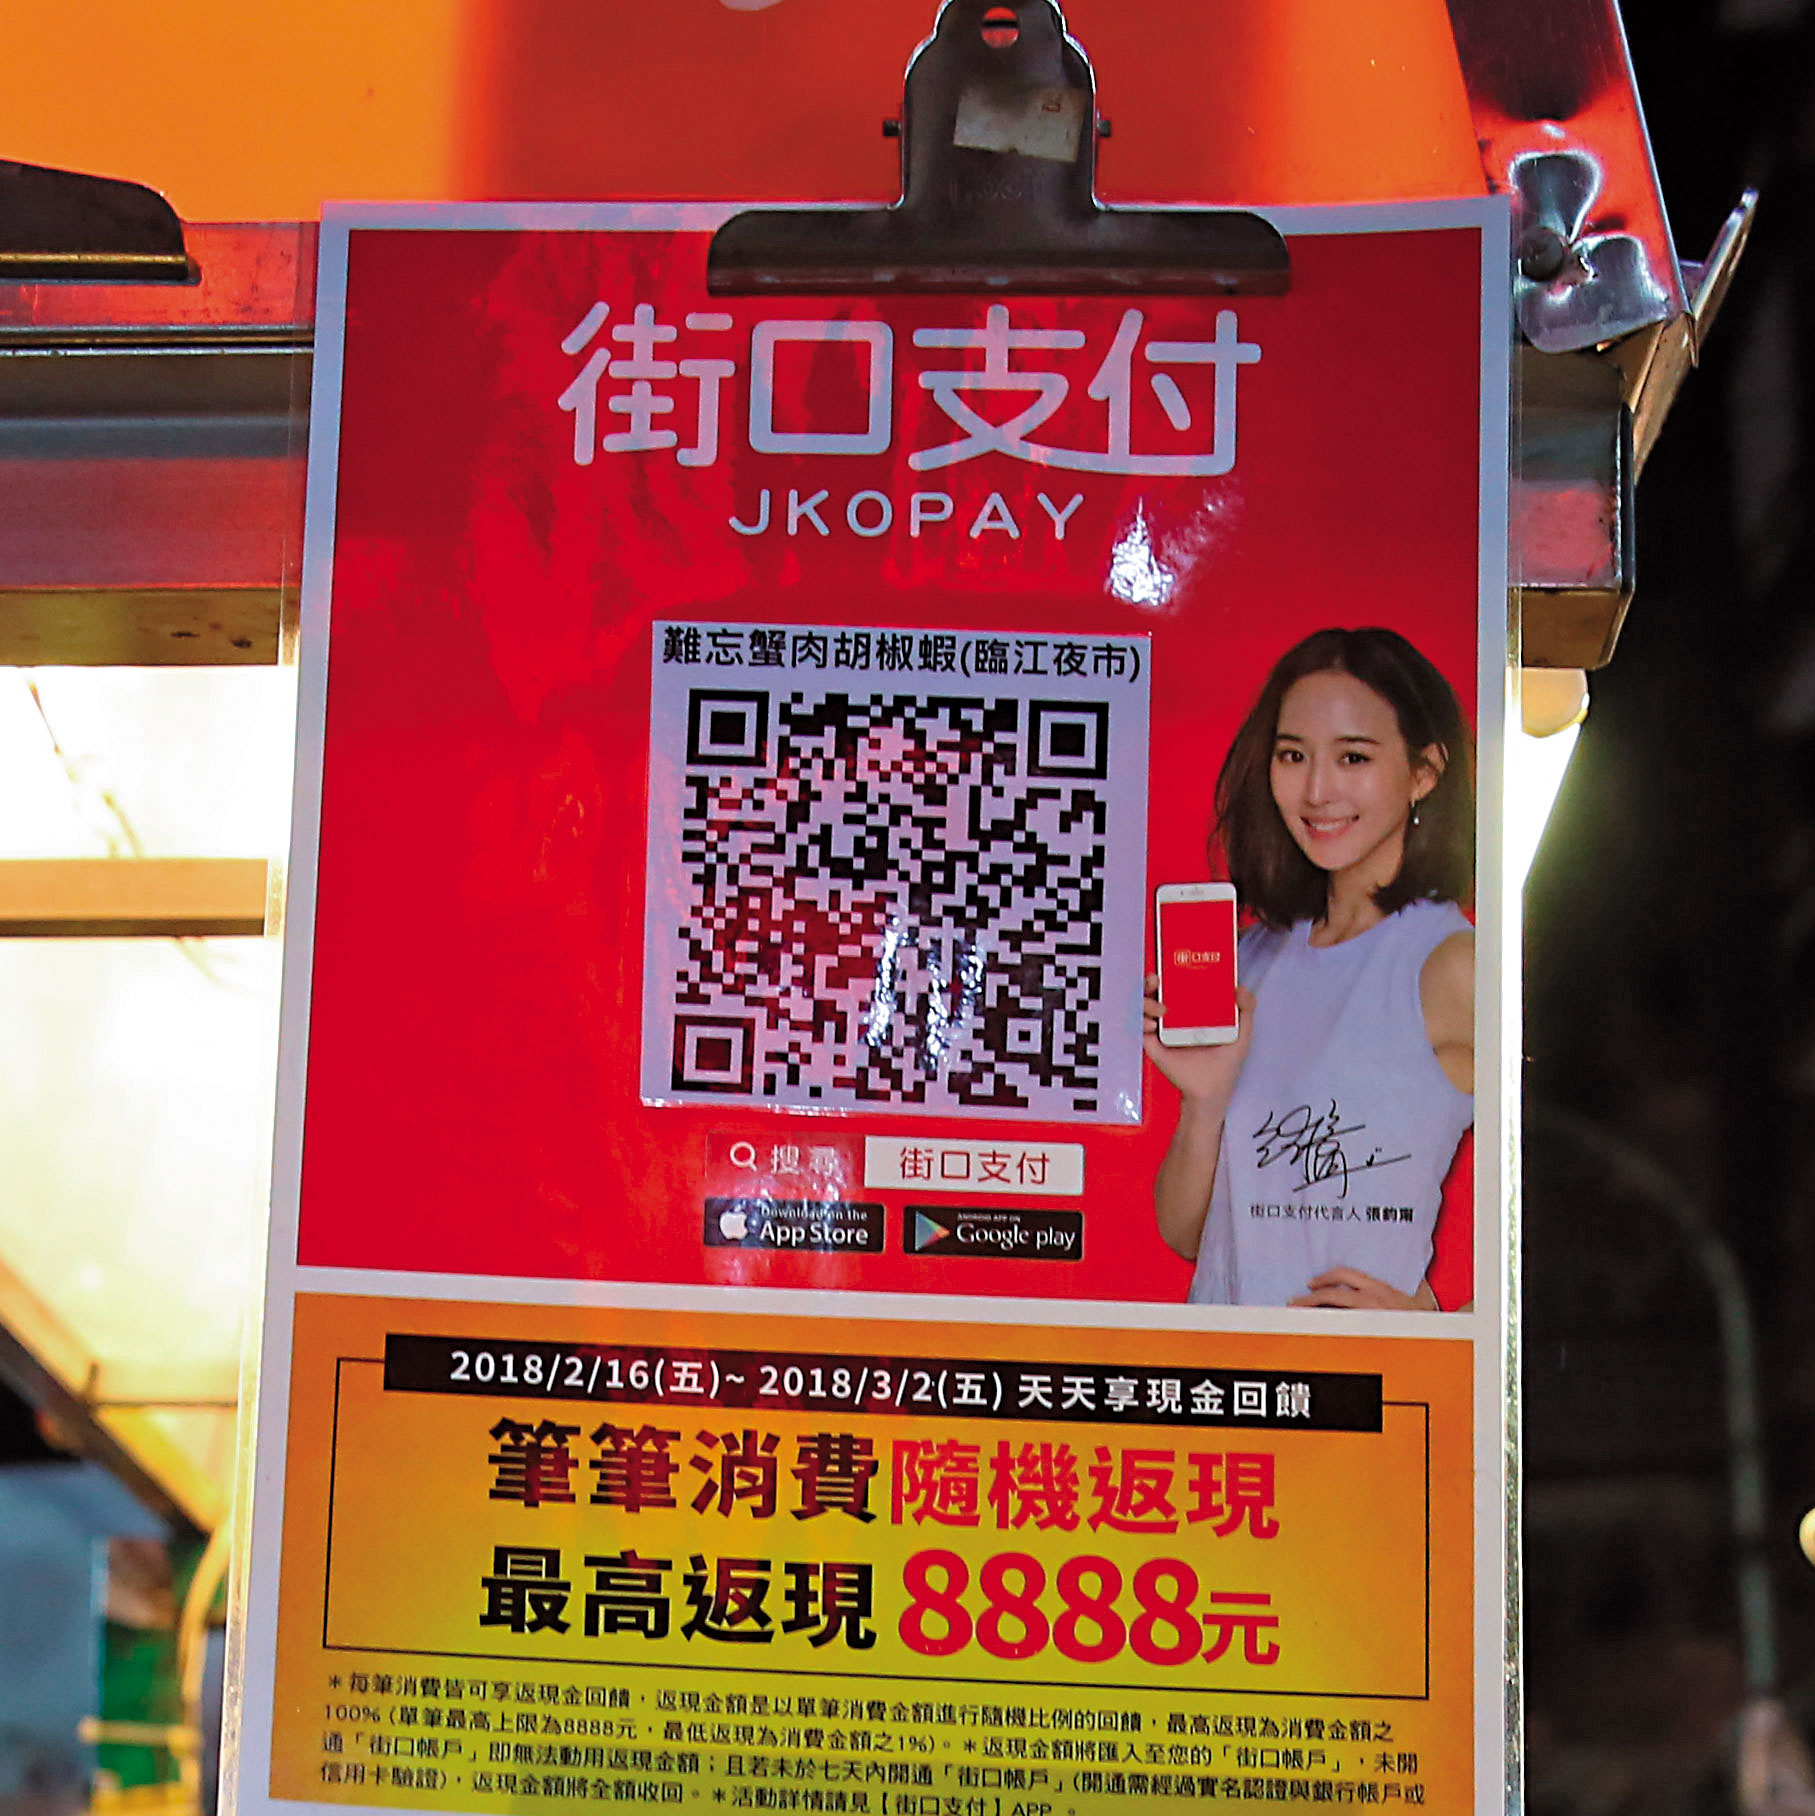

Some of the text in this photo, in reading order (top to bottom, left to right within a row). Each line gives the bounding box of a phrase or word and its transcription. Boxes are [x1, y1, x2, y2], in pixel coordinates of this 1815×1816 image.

[558, 301, 1262, 476] 街口支付
[728, 488, 1084, 540] JKOPAY
[663, 625, 1142, 683] 難忘蟹肉胡椒蝦(臨江夜市)
[770, 1144, 839, 1177] 搜尋
[899, 1145, 1051, 1186] 街口支付
[760, 1205, 823, 1221] Download
[846, 1208, 868, 1221] the
[1250, 1202, 1362, 1223] 街口支付代言人
[760, 1220, 869, 1247] App Store
[956, 1222, 1076, 1252] Google play
[1018, 1372, 1313, 1419] 天天享現金回饋
[487, 1417, 1281, 1540] 筆筆消費隨機返現
